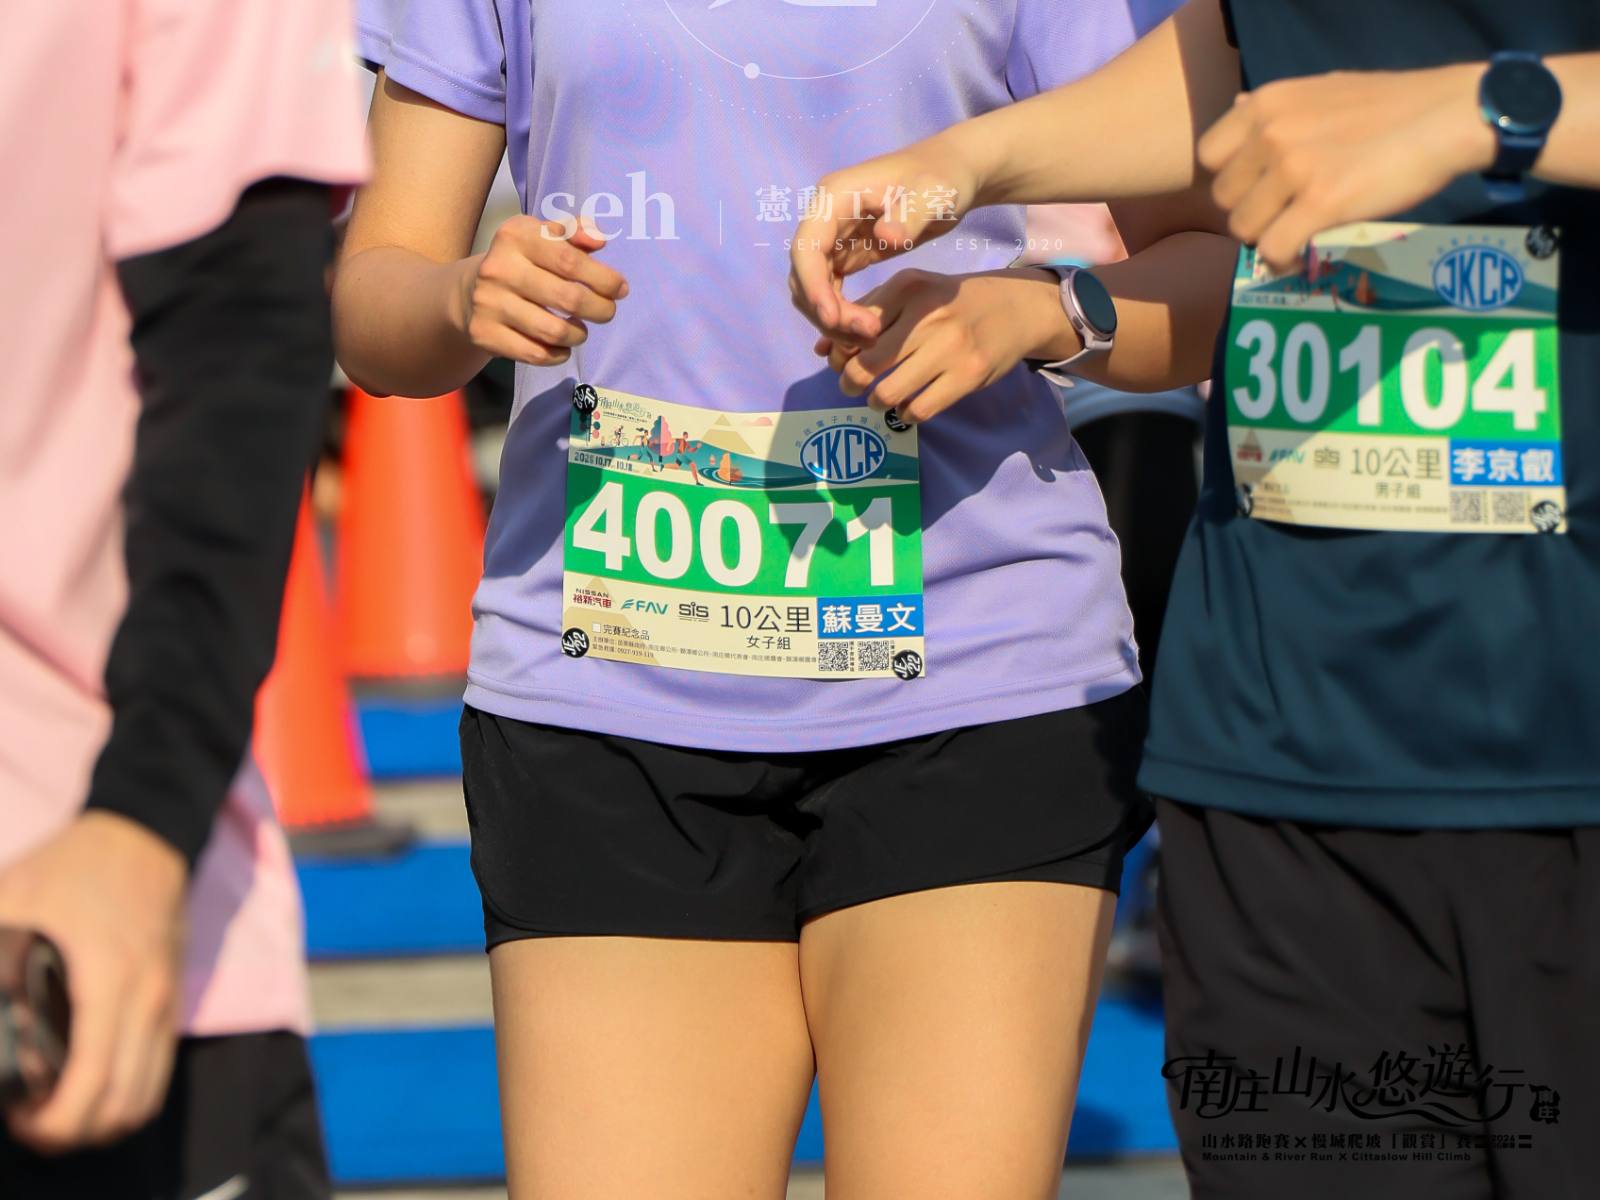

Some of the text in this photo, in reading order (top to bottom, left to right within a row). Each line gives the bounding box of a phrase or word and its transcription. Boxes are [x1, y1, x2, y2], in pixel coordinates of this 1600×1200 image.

[1232, 319, 1548, 431] 30104
[1350, 448, 1443, 480] 10公里
[1452, 447, 1555, 484] 李京叡
[572, 481, 895, 588] 40071
[575, 588, 609, 599] NISSAN
[603, 624, 650, 641] 完賽紀念品
[720, 605, 812, 633] 10公里
[822, 603, 917, 634] 蘇曼文
[746, 635, 791, 650] 女子組
